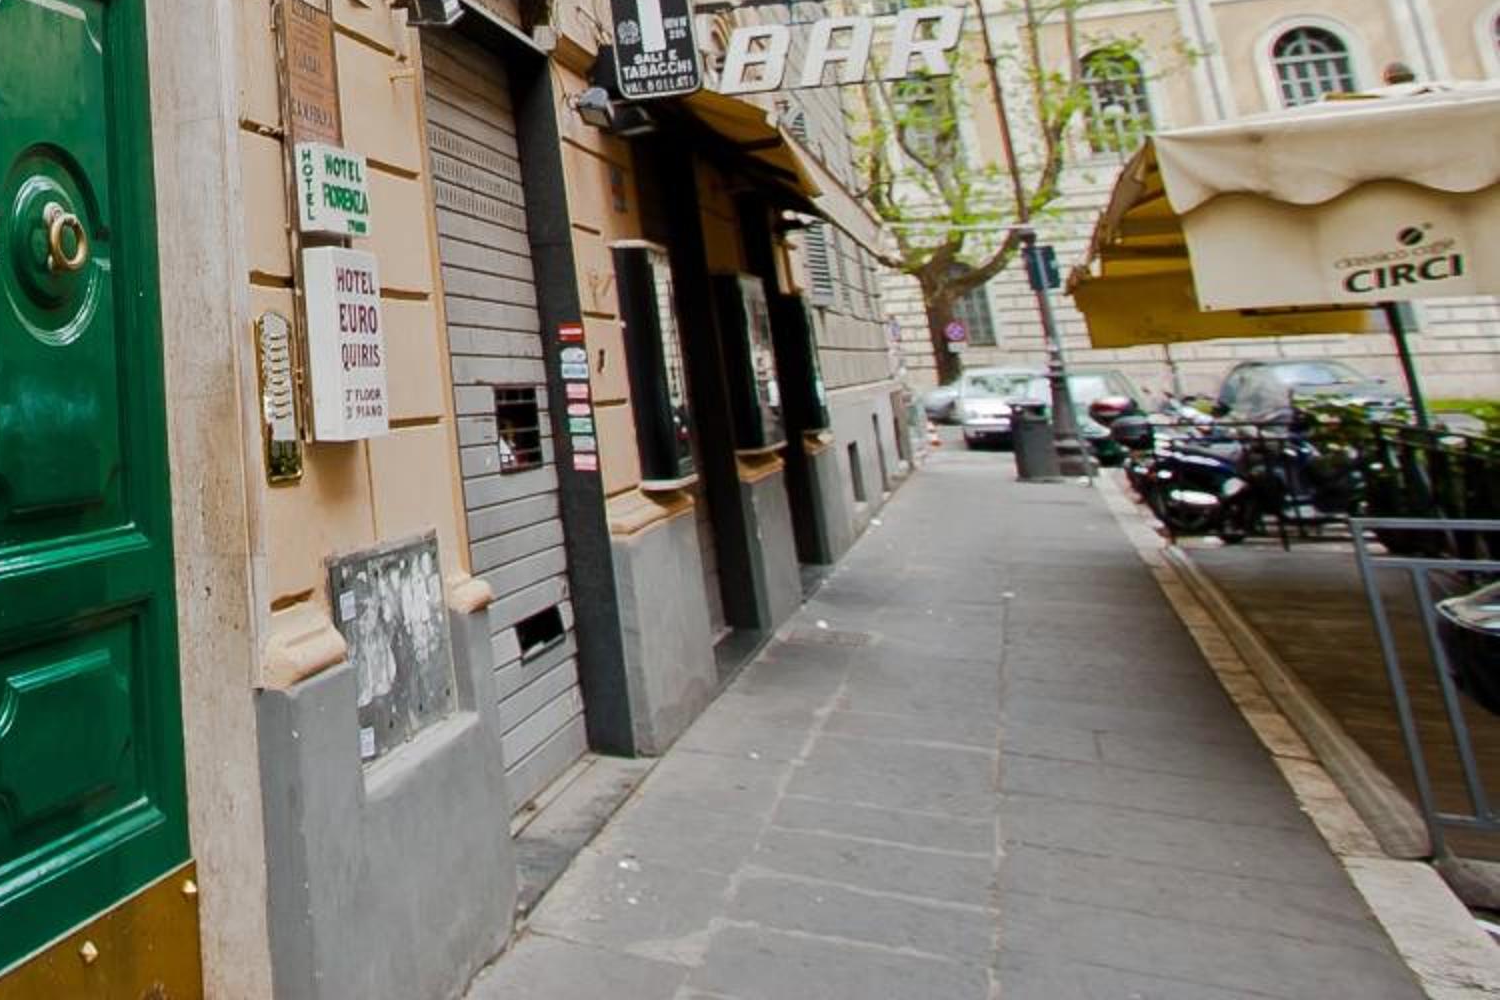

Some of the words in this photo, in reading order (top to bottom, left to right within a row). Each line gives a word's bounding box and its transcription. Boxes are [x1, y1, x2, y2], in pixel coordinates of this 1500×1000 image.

[719, 6, 967, 94] BAR
[622, 60, 693, 80] TABACCHI
[324, 154, 362, 183] HOTEL
[301, 149, 316, 220] HOTEL
[336, 267, 376, 295] HOTEL
[1344, 254, 1463, 293] CIRCI
[339, 303, 378, 334] EURO
[341, 343, 381, 371] QUIRIS
[355, 388, 381, 401] FLOOR
